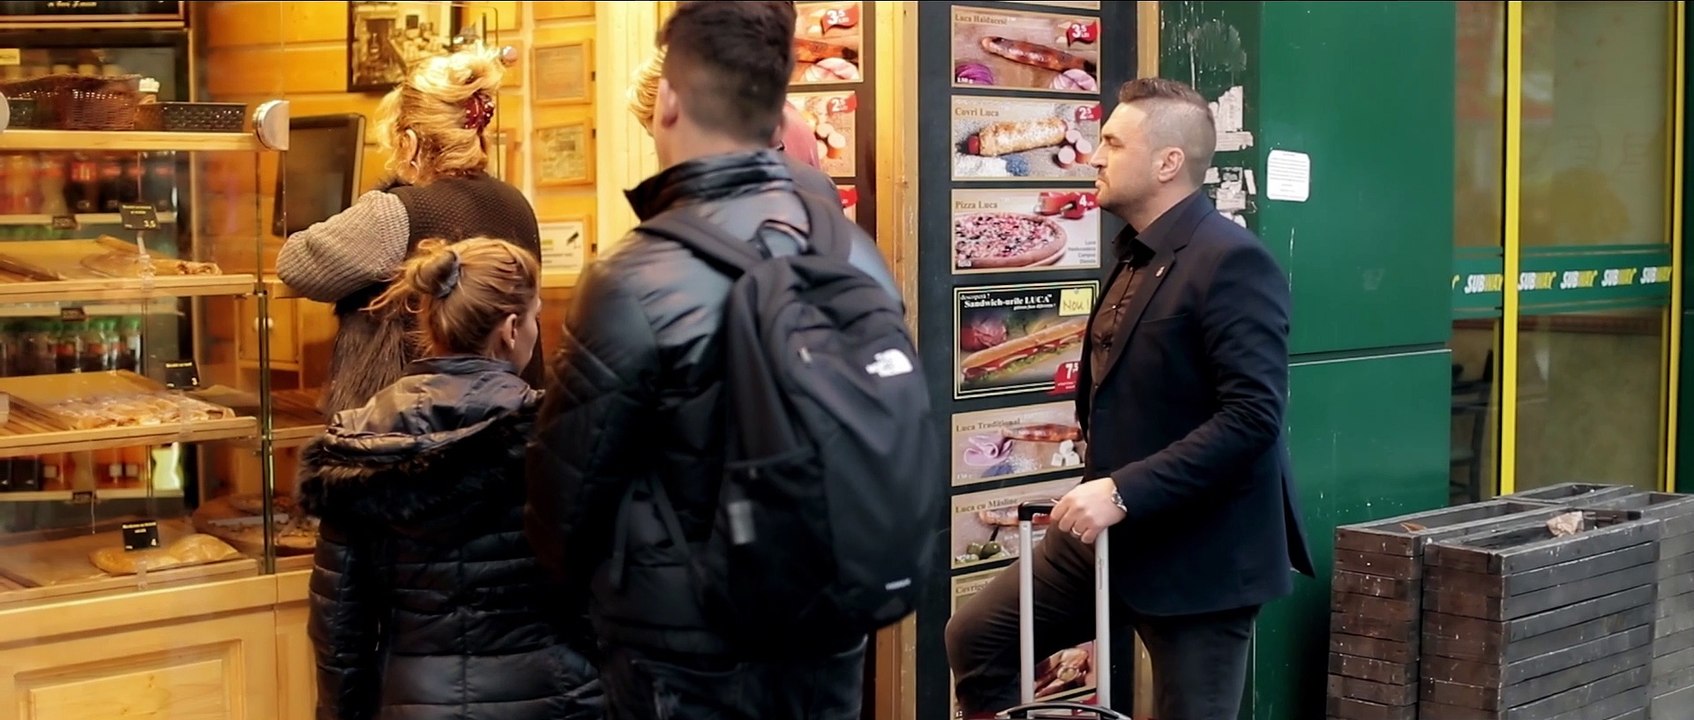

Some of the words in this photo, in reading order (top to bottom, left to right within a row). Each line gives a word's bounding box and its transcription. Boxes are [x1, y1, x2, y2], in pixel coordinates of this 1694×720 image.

[955, 13, 972, 22] Luca
[980, 107, 999, 117] Luca
[955, 200, 976, 210] Pizza
[978, 200, 998, 209] Luca
[1517, 271, 1557, 291] SUBWAY
[1560, 269, 1598, 290] SUBWAY
[1601, 267, 1637, 287] SUBWAY
[964, 296, 1024, 309] Sandwich-urile
[1024, 295, 1051, 305] LUCA
[956, 424, 976, 432] Luca
[955, 505, 975, 513] Luca
